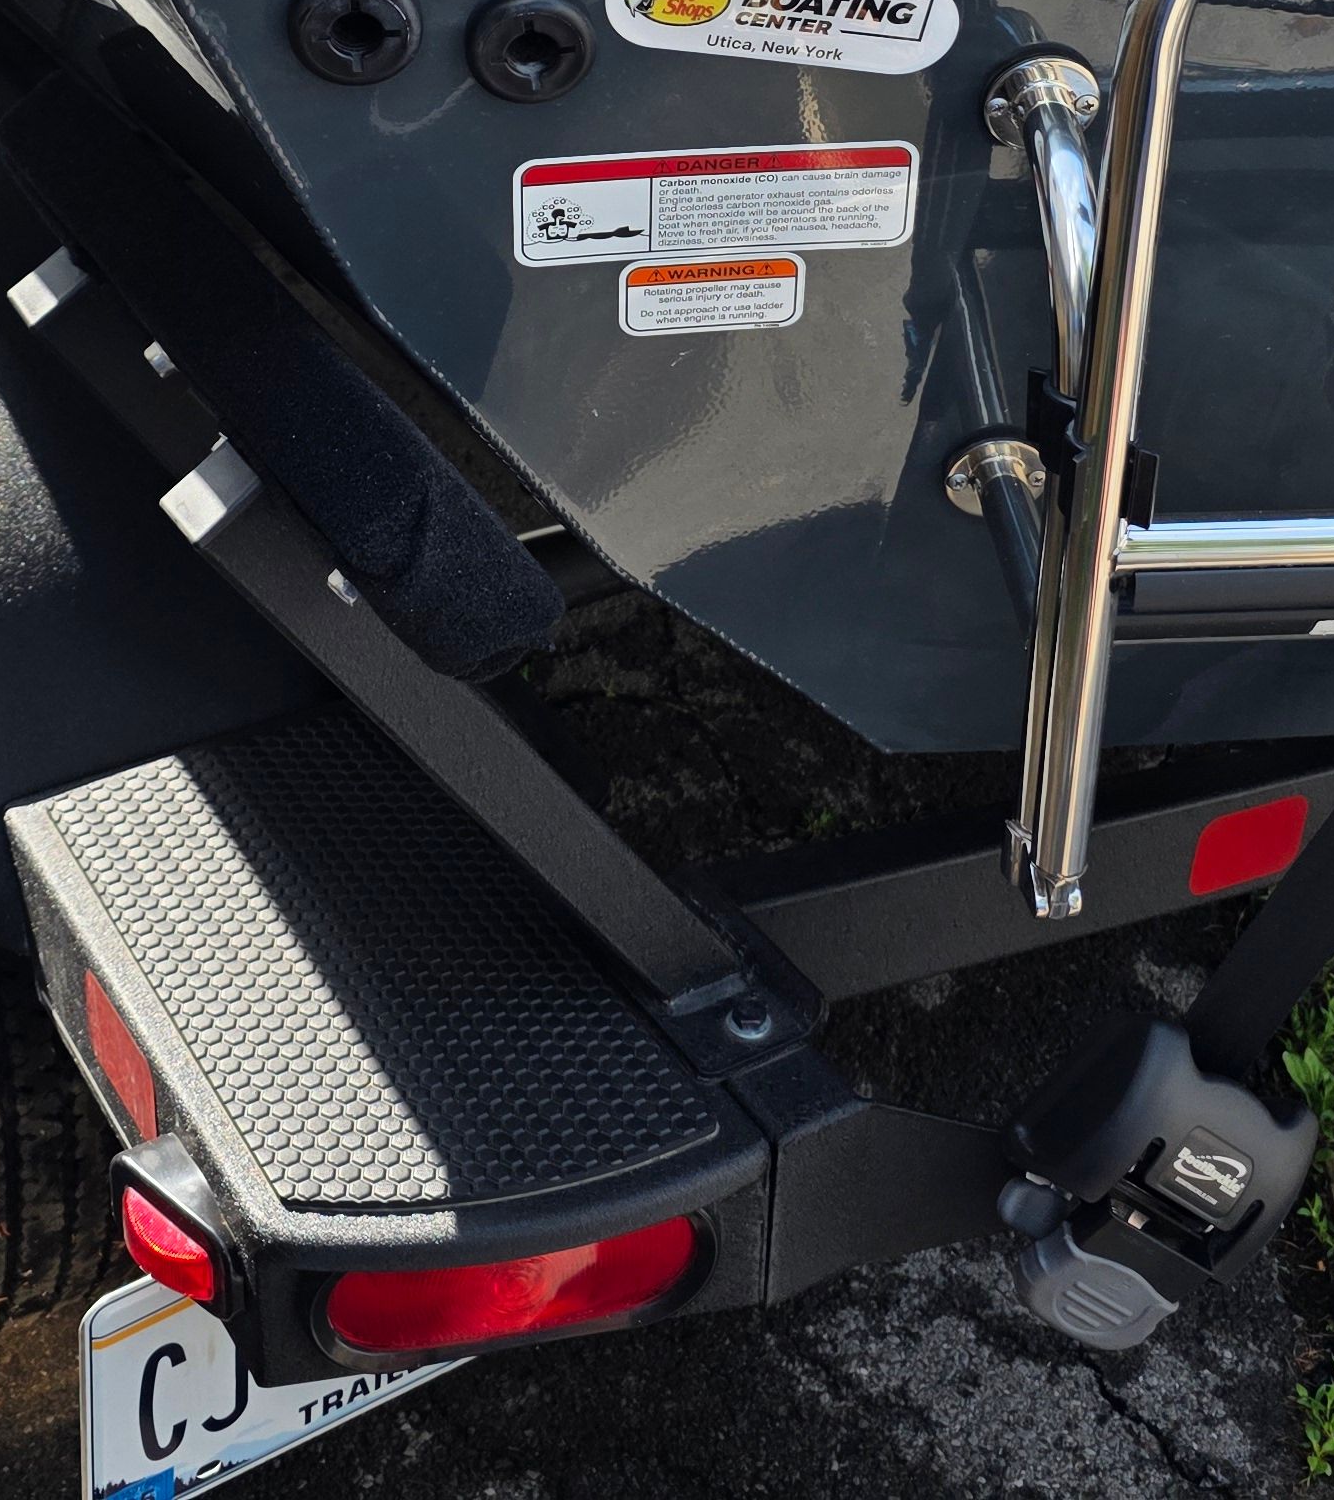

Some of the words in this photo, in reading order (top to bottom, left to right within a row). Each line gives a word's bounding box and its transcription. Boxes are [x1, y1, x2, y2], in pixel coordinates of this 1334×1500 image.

[662, 0, 715, 20] Shops
[735, 12, 832, 35] CENTER
[706, 34, 755, 52] Utica,
[762, 41, 799, 56] New
[805, 45, 843, 61] York
[677, 158, 759, 171] DANGER
[659, 179, 697, 187] Carbon
[701, 176, 751, 185] monoxide
[755, 174, 778, 184] (CO)
[834, 171, 858, 179] brain
[862, 170, 901, 178] damage
[659, 196, 692, 205] Engine
[718, 193, 764, 203] generator
[767, 191, 804, 199] exhaust
[809, 189, 849, 197] contains
[852, 187, 893, 195] odorless
[672, 187, 702, 195] death.
[680, 203, 723, 211] colorless
[763, 199, 810, 207] monoxide
[814, 199, 834, 207] gas.
[659, 213, 694, 221] Carbon
[698, 210, 745, 219] monoxide
[781, 207, 815, 215] around
[658, 222, 680, 230] boat
[683, 220, 708, 228] when
[712, 218, 750, 227] engines
[765, 216, 816, 226] generators
[699, 228, 722, 236] fresh
[726, 227, 740, 235] air,
[751, 226, 767, 234] you
[658, 238, 704, 246] dizziness,
[720, 235, 777, 243] drowsiness.
[668, 266, 755, 279] WARNING
[686, 285, 728, 296] propeller
[731, 284, 750, 292] may
[659, 295, 692, 303] serious
[695, 293, 721, 302] injury
[675, 306, 718, 316] approach
[656, 316, 681, 324] when
[684, 314, 715, 323] engine
[729, 312, 767, 320] running.
[298, 1369, 414, 1425] TRAI
